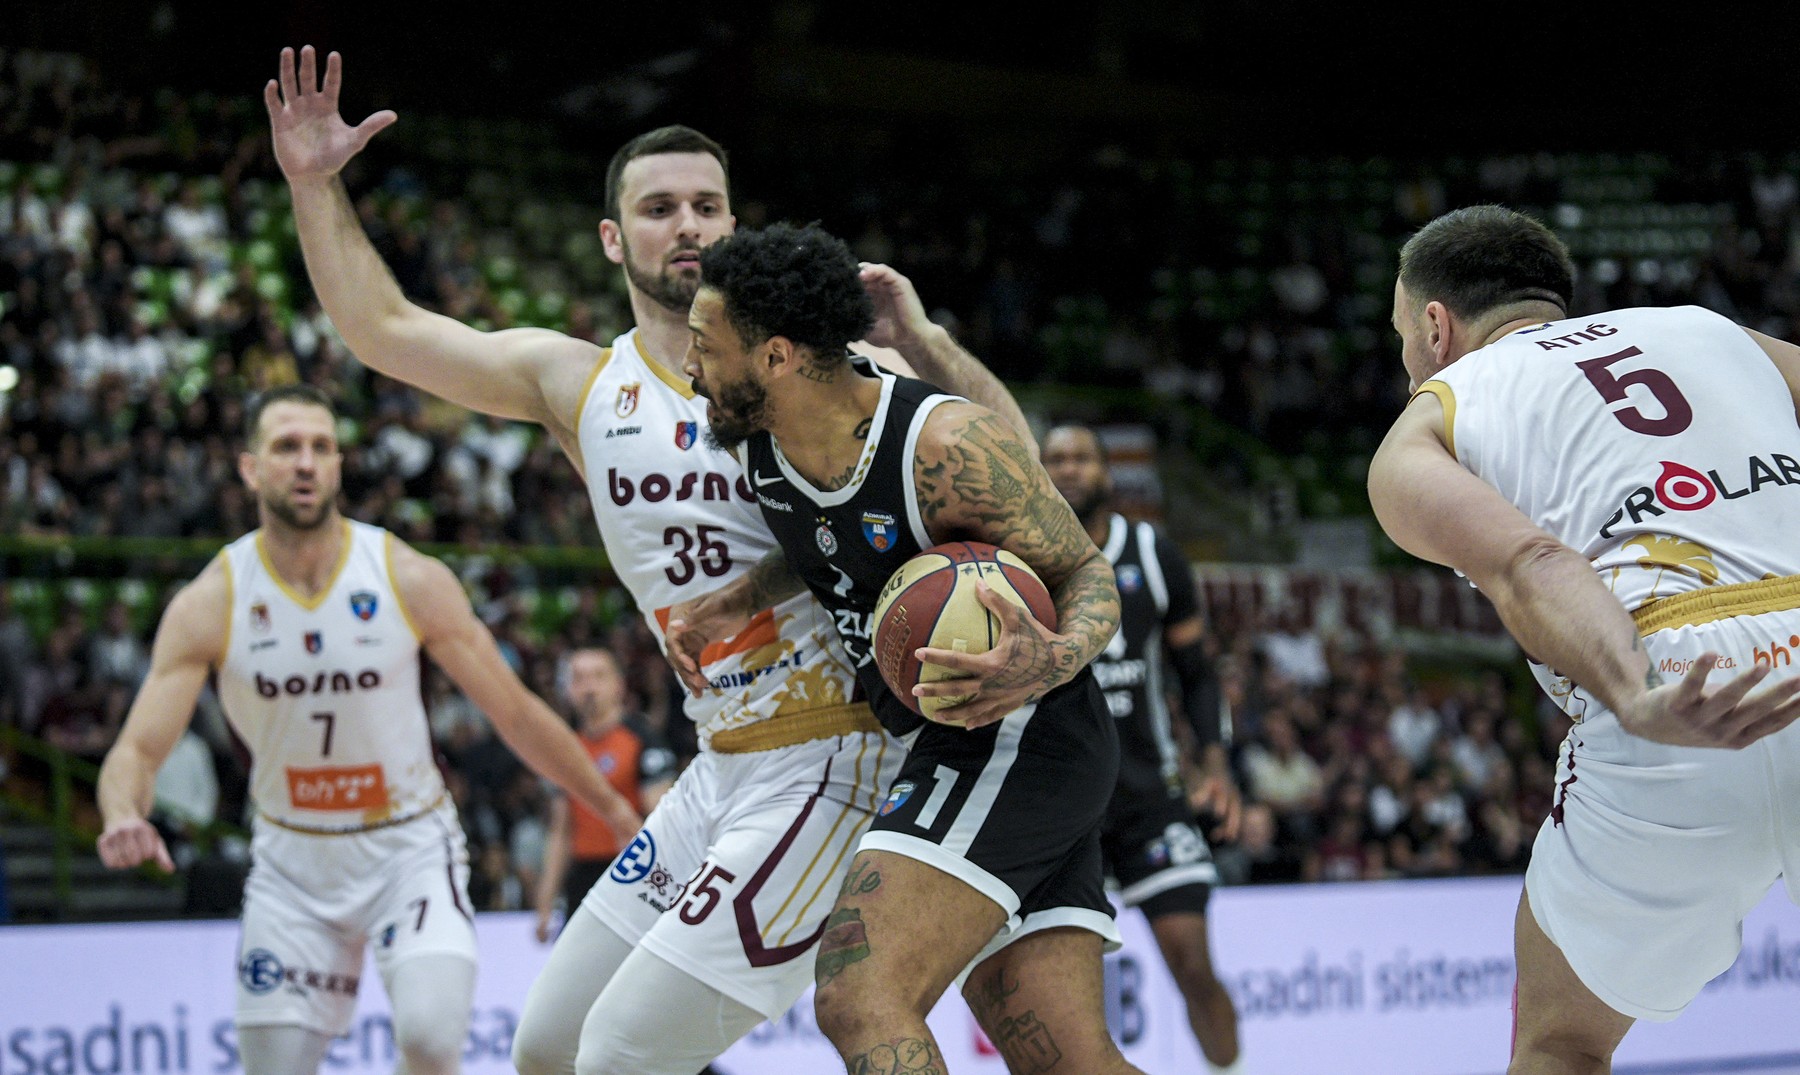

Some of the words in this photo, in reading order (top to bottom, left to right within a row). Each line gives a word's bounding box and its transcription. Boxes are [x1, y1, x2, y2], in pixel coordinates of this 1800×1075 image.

[1534, 322, 1619, 351] ATIĆ
[1574, 345, 1693, 437] 5
[663, 524, 733, 586] 35
[311, 712, 335, 758] 7
[914, 764, 960, 830] 1
[408, 898, 428, 932] 7
[0, 1002, 190, 1075] sadni
